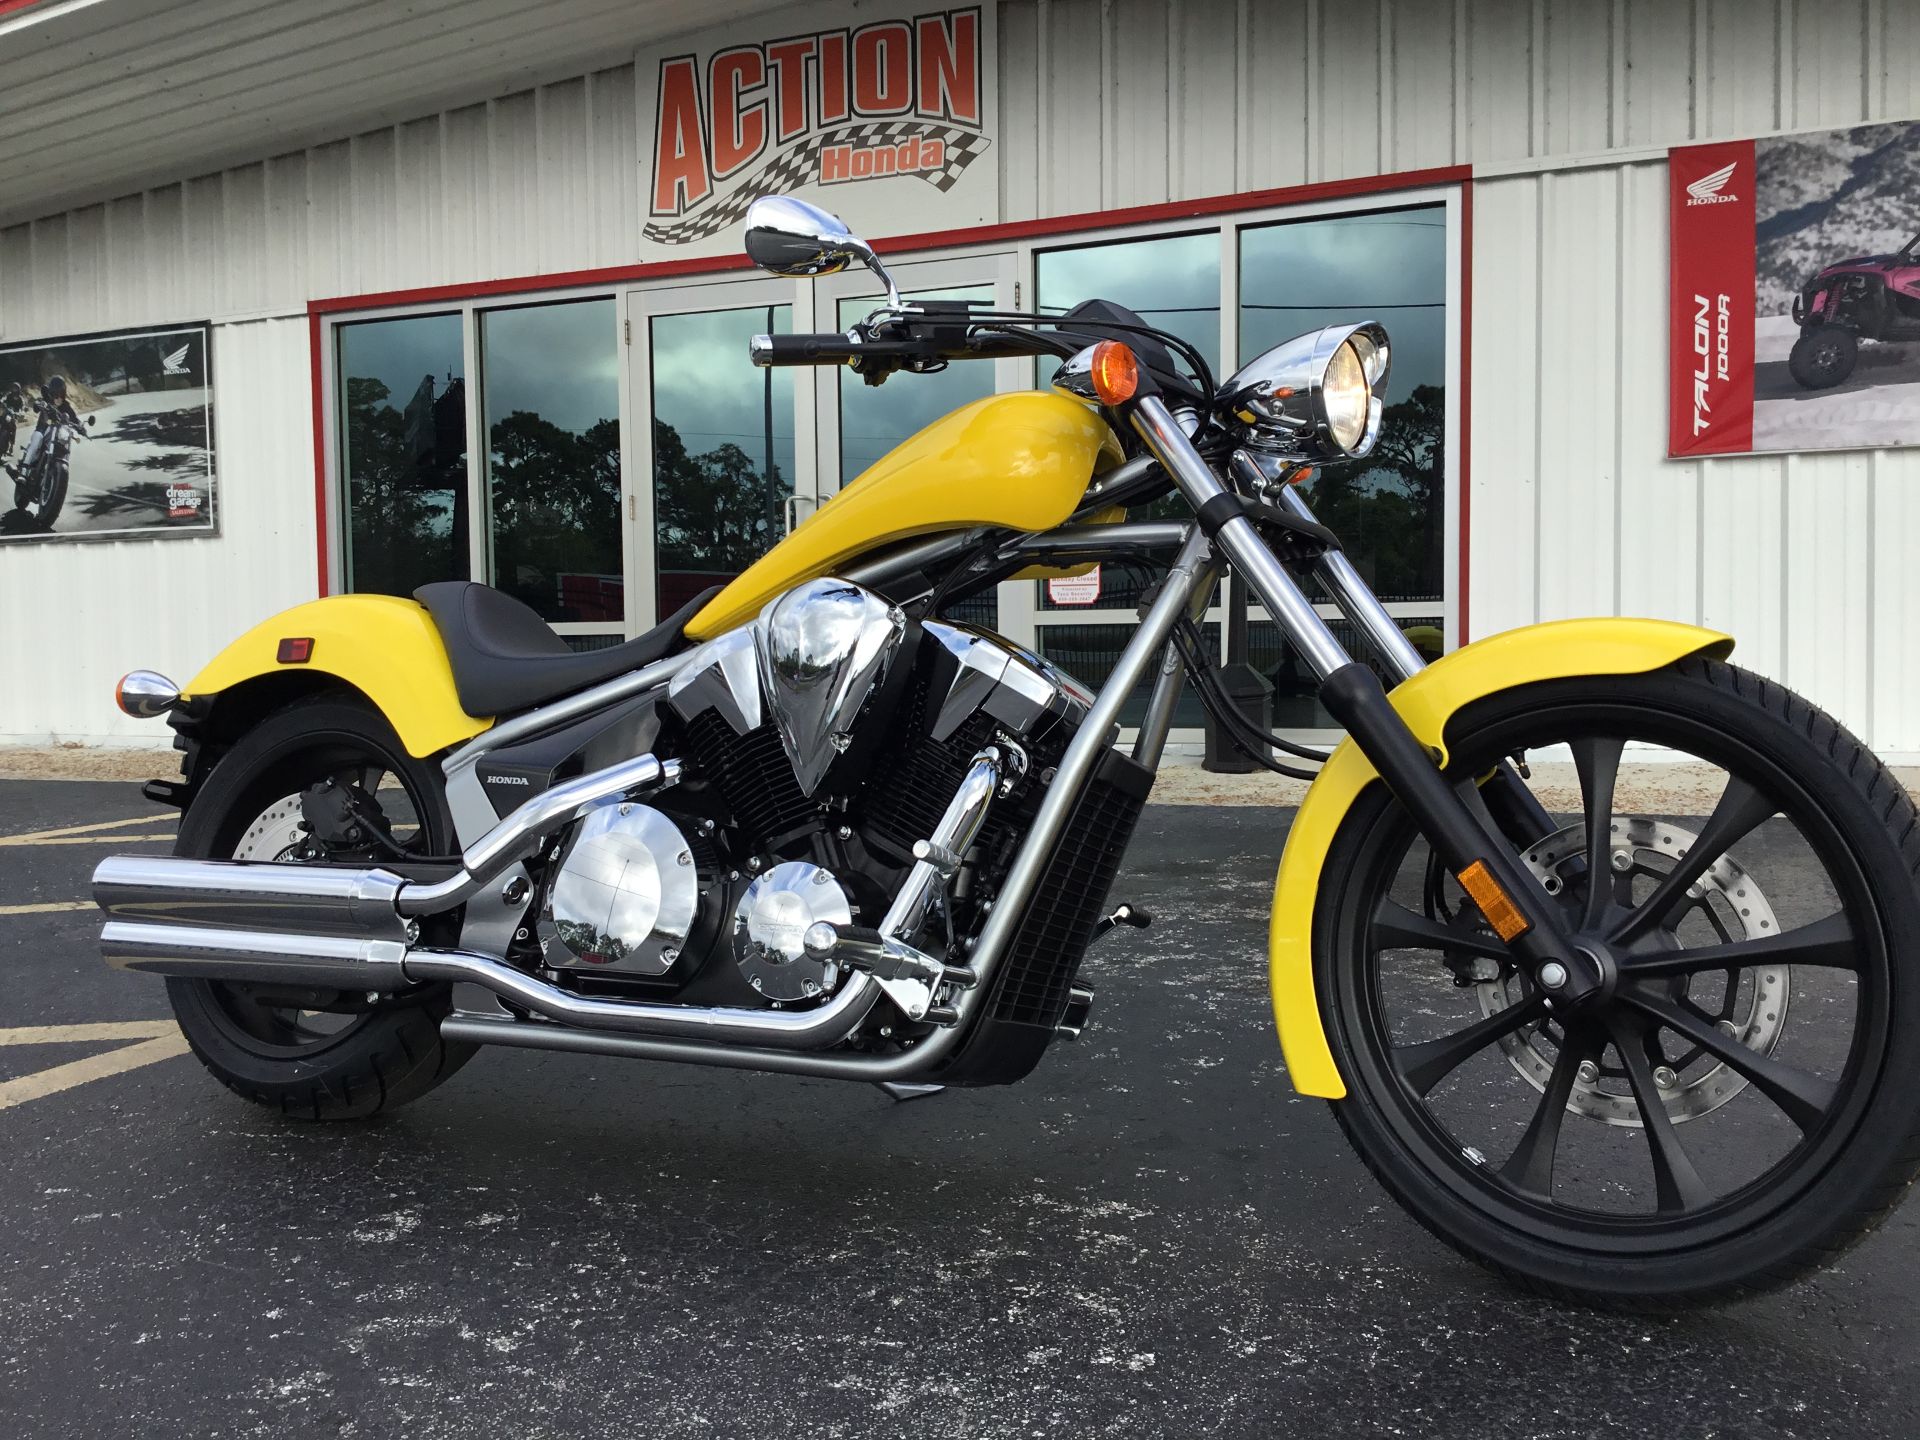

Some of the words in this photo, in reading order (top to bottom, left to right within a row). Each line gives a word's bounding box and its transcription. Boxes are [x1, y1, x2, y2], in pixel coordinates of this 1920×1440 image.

[650, 5, 983, 217] ACTION
[819, 134, 946, 186] Honda
[1686, 194, 1739, 206] HONDA
[1717, 293, 1731, 382] 1000R
[163, 367, 191, 376] HONDA
[1694, 294, 1711, 436] TALON
[166, 484, 197, 498] dream
[169, 497, 202, 510] garage
[487, 775, 529, 785] HONDA
